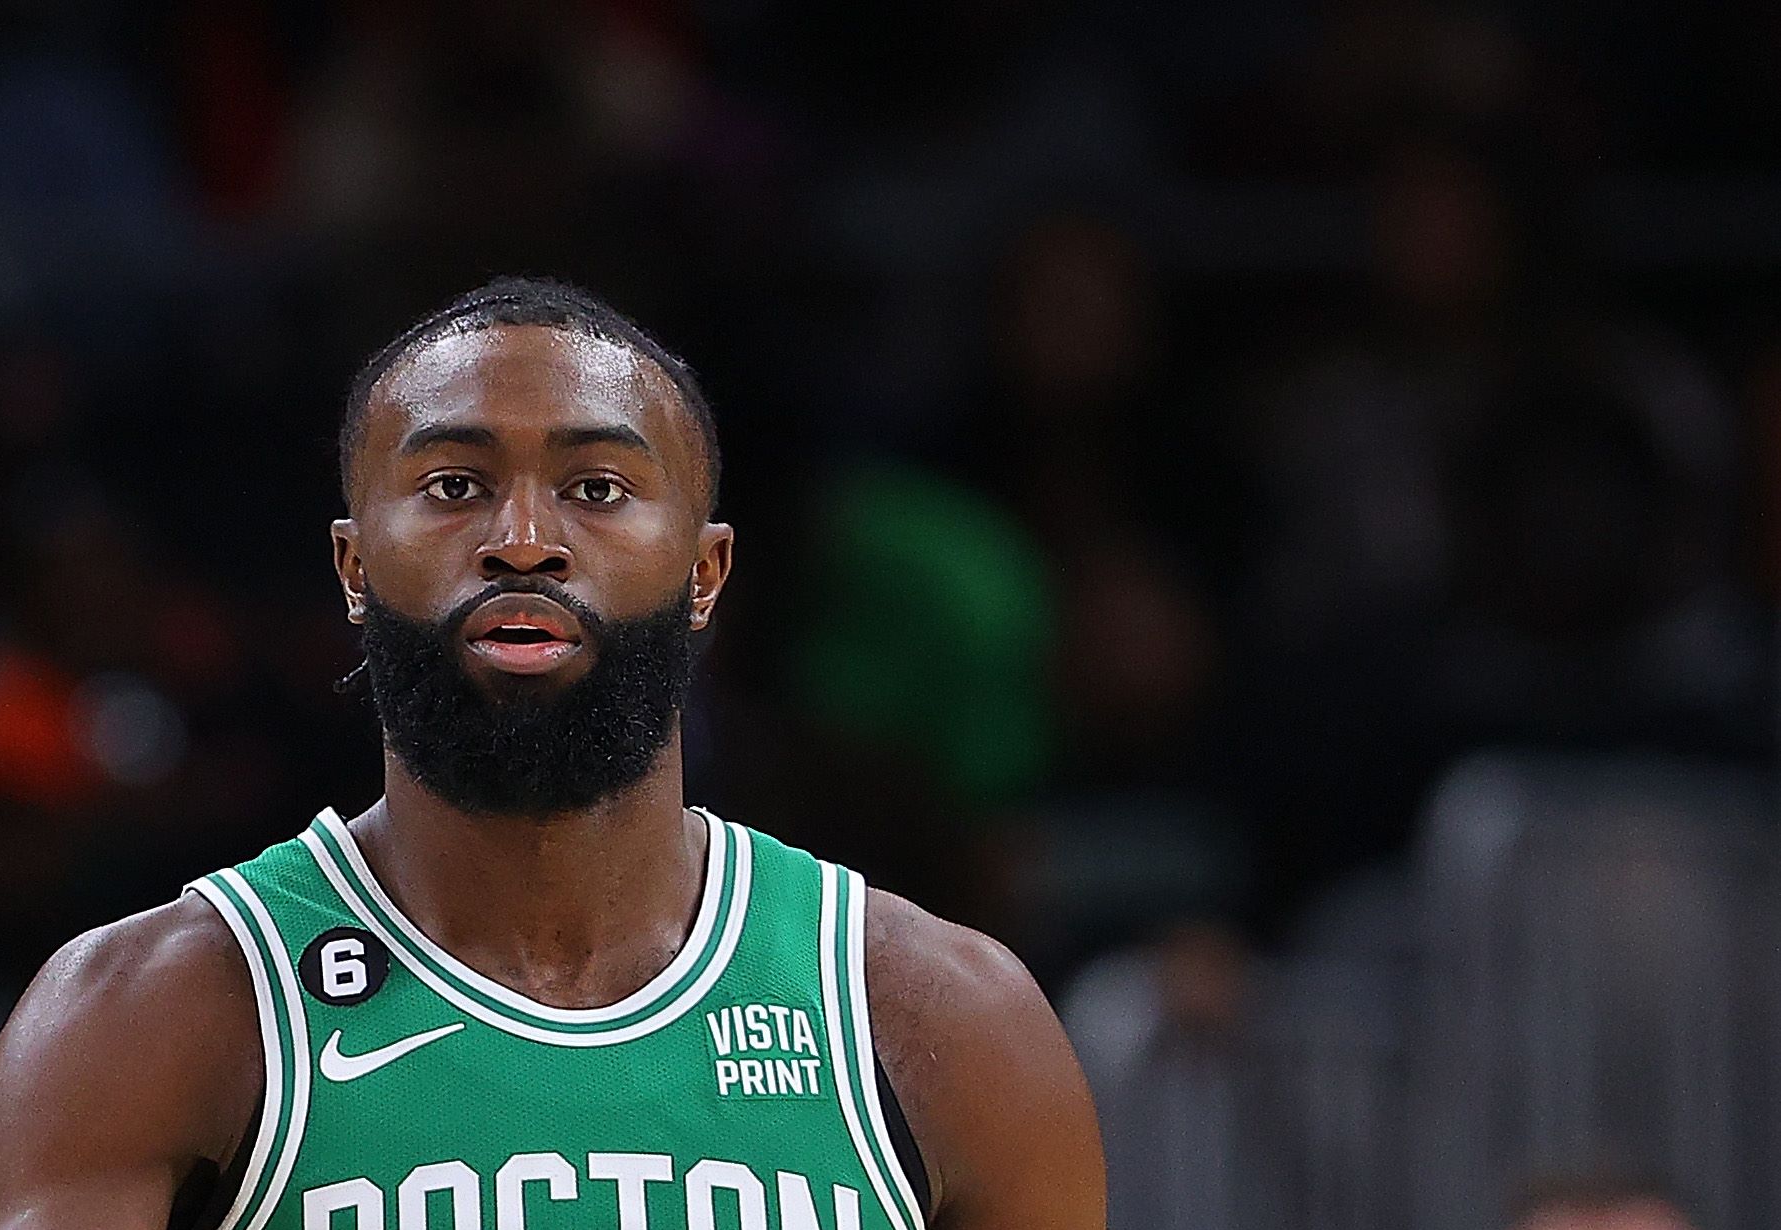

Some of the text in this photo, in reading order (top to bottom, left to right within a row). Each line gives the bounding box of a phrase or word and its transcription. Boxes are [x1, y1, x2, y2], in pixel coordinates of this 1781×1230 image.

[321, 938, 367, 997] 6
[706, 1004, 820, 1056] VISTA
[716, 1059, 821, 1096] PRINT
